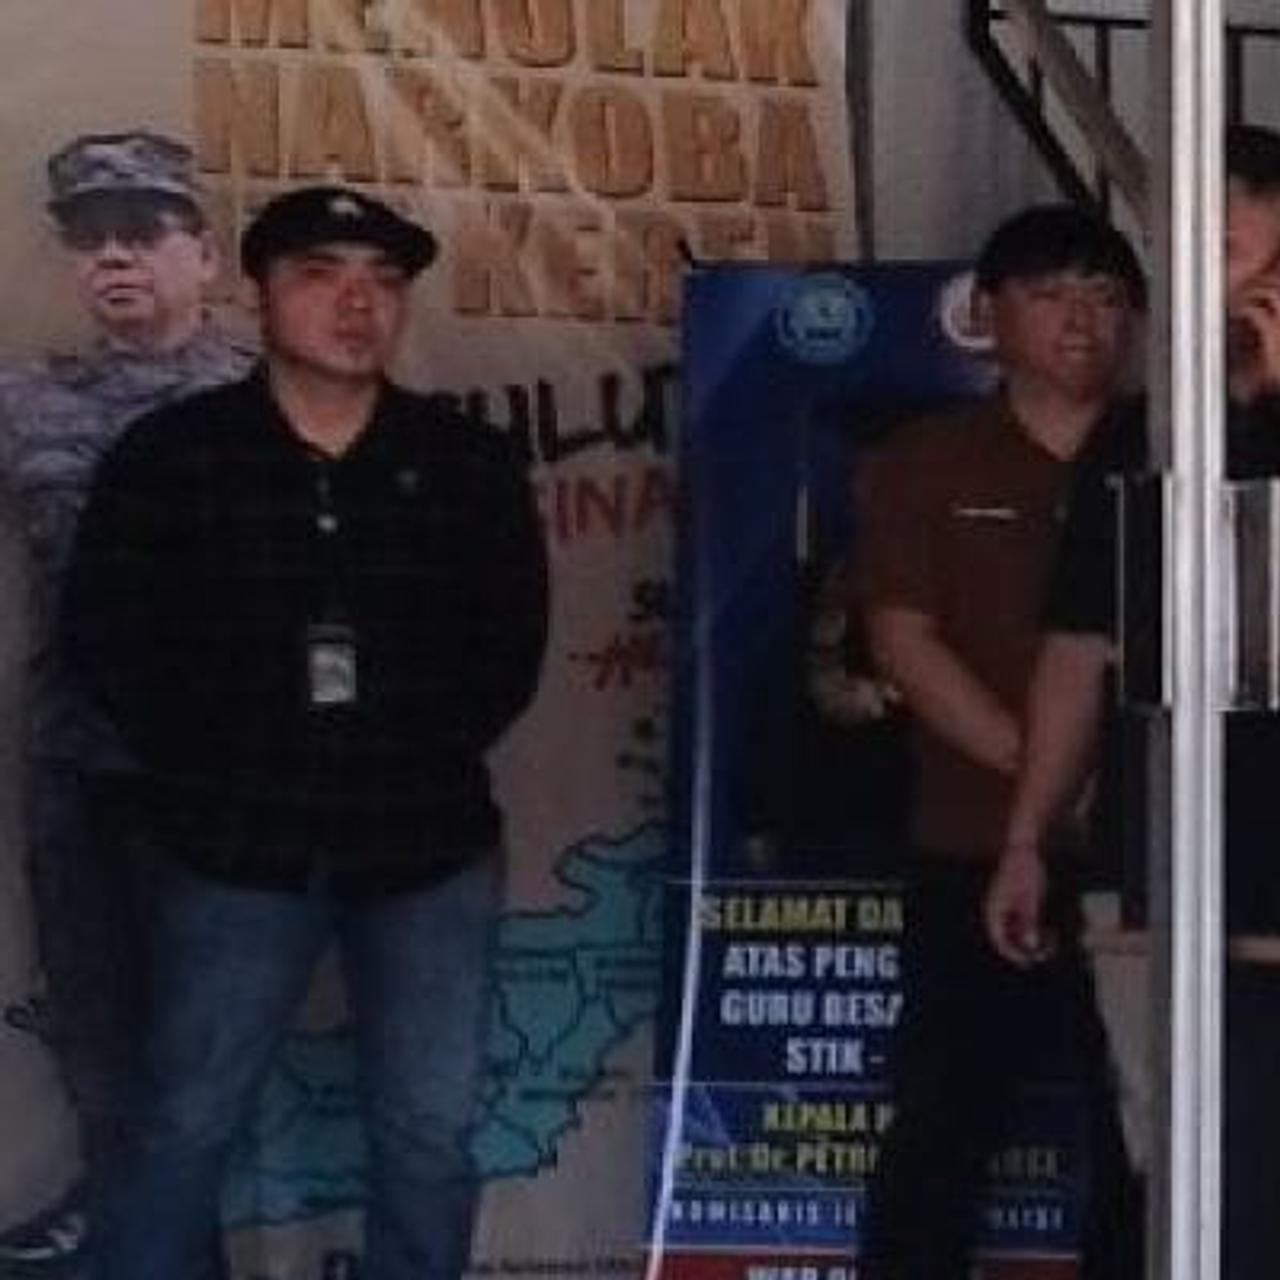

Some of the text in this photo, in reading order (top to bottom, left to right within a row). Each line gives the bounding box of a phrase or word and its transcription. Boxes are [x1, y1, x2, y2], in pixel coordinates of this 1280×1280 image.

[700, 893, 846, 932] SELAMAT
[722, 943, 806, 980] ATAS
[719, 988, 815, 1026] GURU
[785, 1036, 863, 1076] STIK
